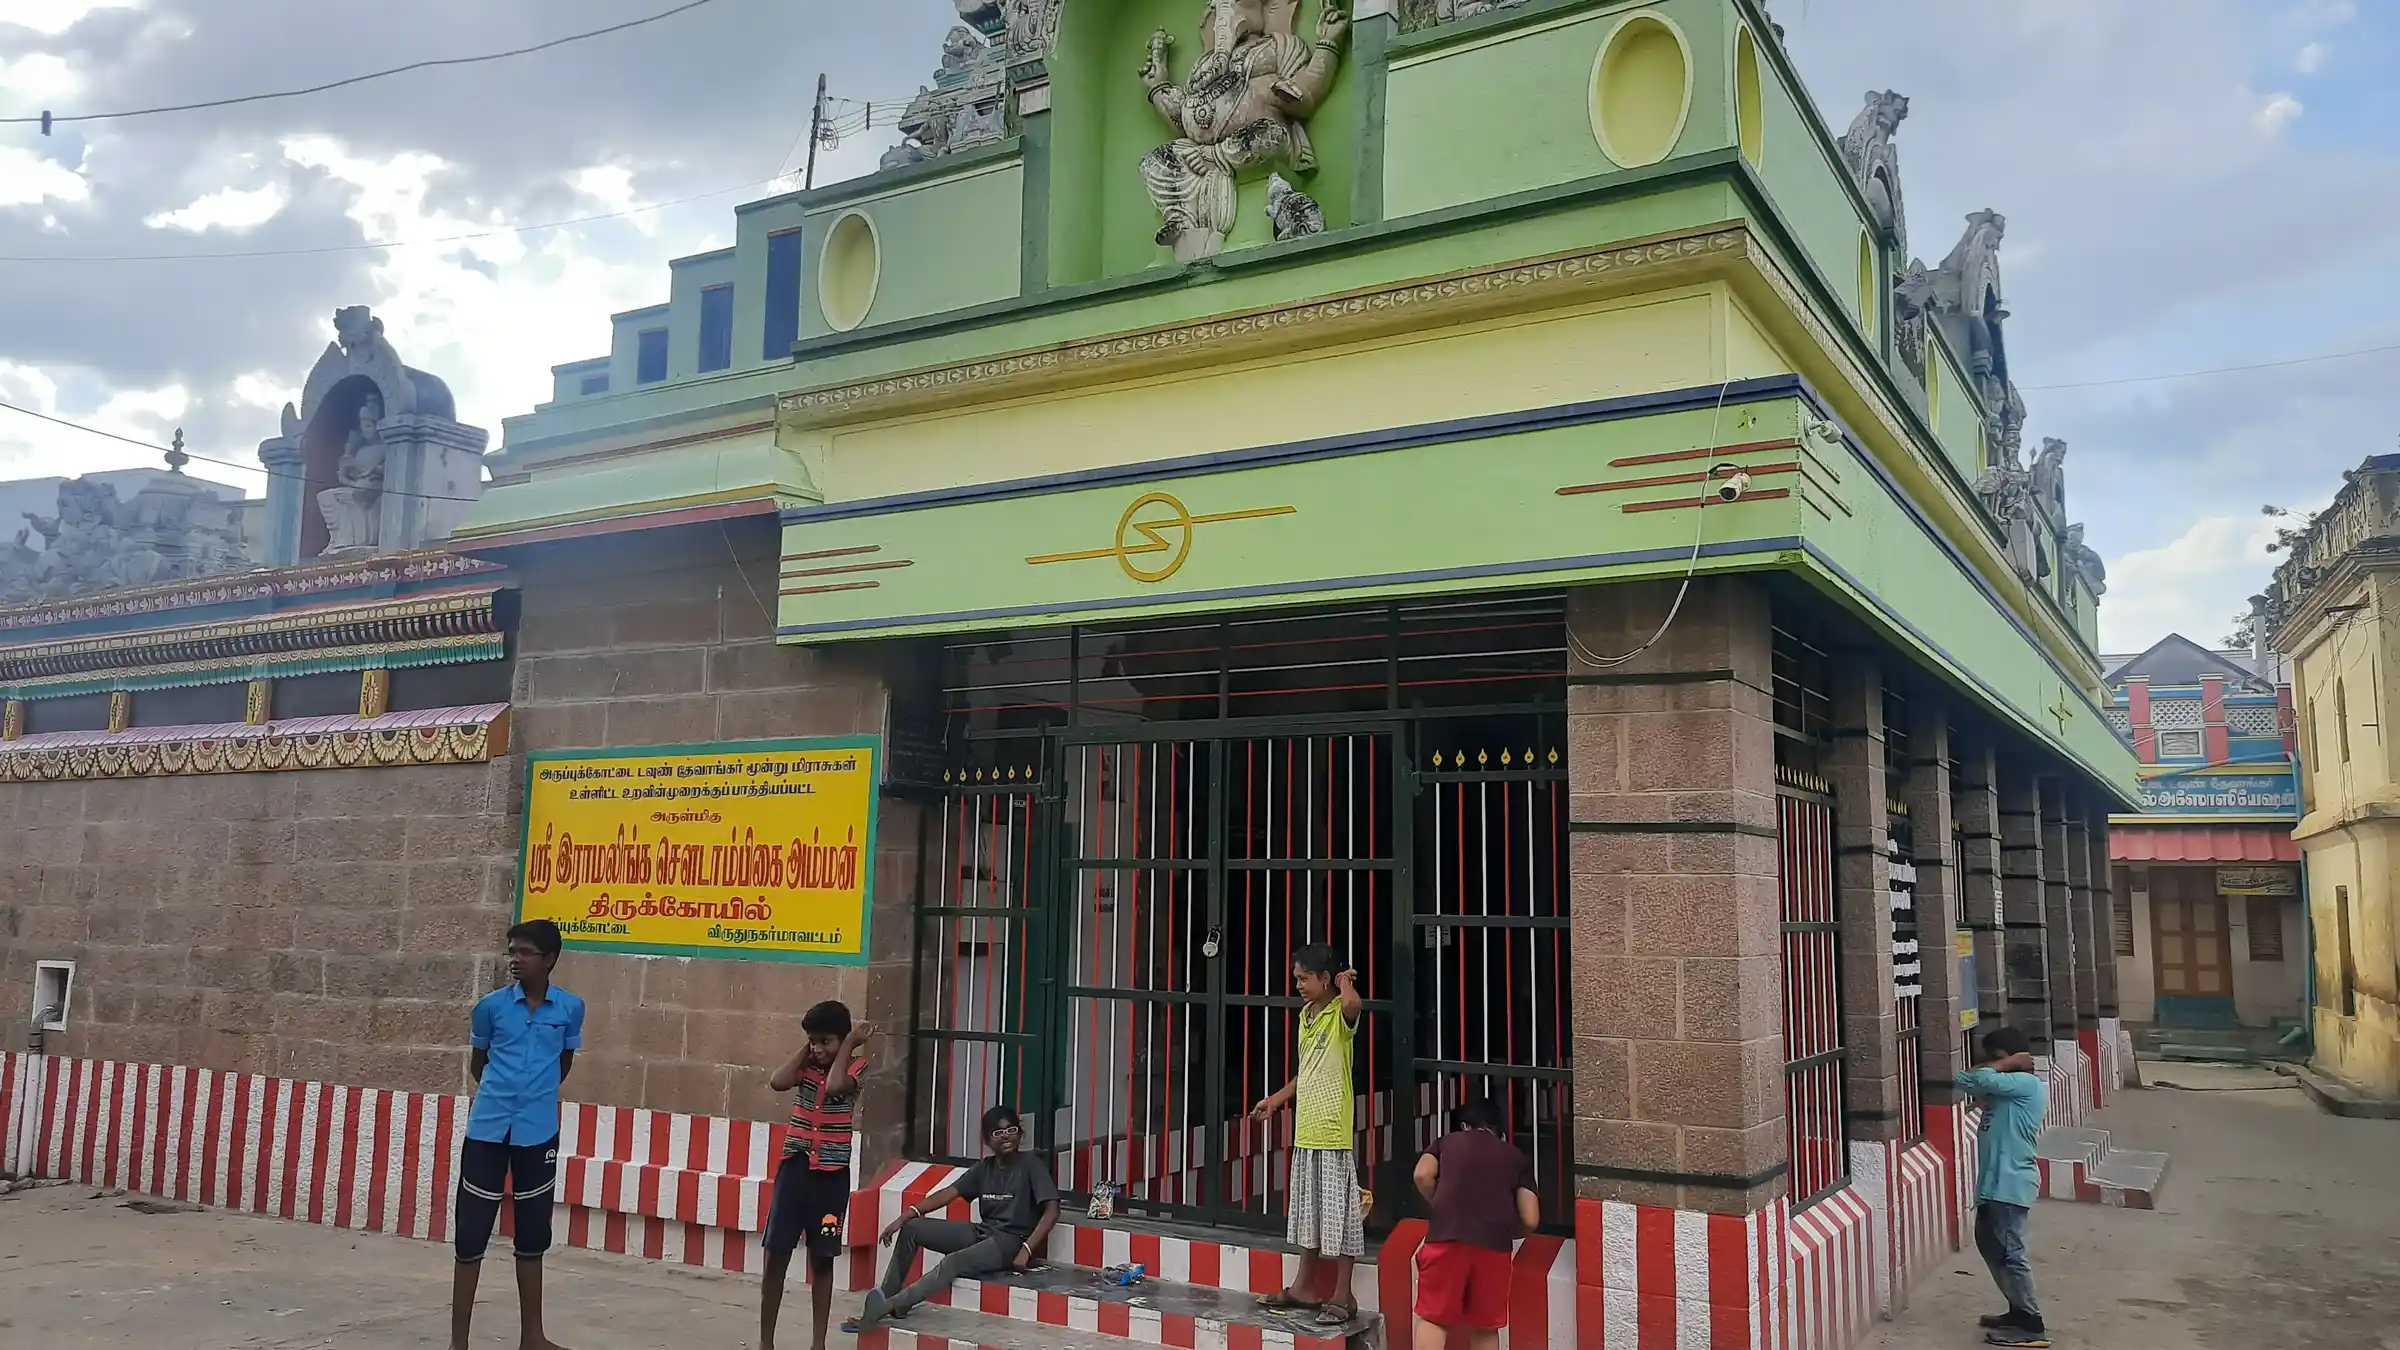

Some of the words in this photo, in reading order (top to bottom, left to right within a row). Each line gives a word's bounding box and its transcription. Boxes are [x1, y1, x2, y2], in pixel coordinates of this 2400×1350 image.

[540, 764, 634, 782] அருப்புக்கோட்டை
[637, 762, 673, 779] டவுண்
[677, 759, 743, 778] தேவாங்கர்
[746, 758, 788, 776] மூன்று
[792, 755, 857, 773] மிராசுகள்
[569, 785, 619, 800] உள்ளிட்ட
[650, 808, 722, 824] அருள்மிகு
[555, 823, 652, 892] இராமலிங்க
[786, 824, 858, 891] அம்மன்
[585, 892, 772, 920] திருக்கோயில்
